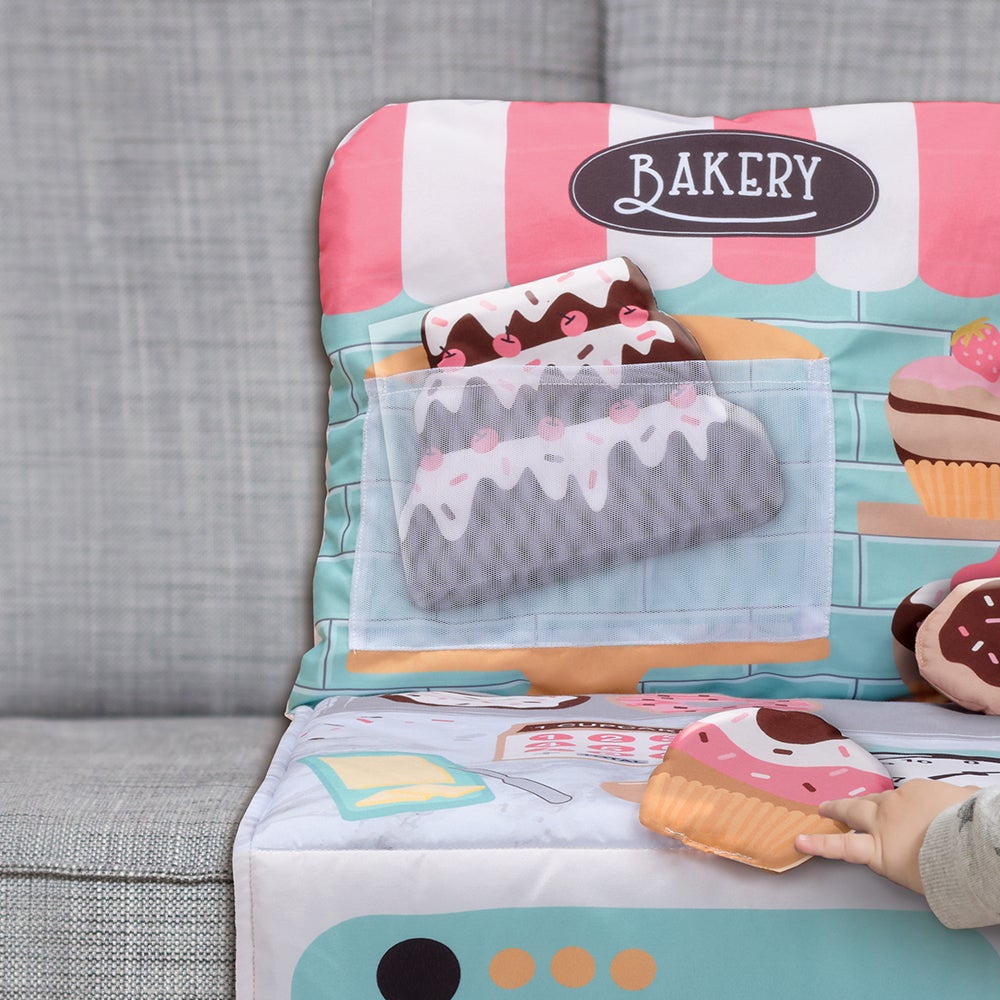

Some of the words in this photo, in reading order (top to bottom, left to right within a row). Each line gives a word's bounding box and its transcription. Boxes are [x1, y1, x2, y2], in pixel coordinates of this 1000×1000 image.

[613, 151, 822, 223] BAKERY
[557, 722, 677, 734] CUPCAK
[600, 734, 623, 742] 2
